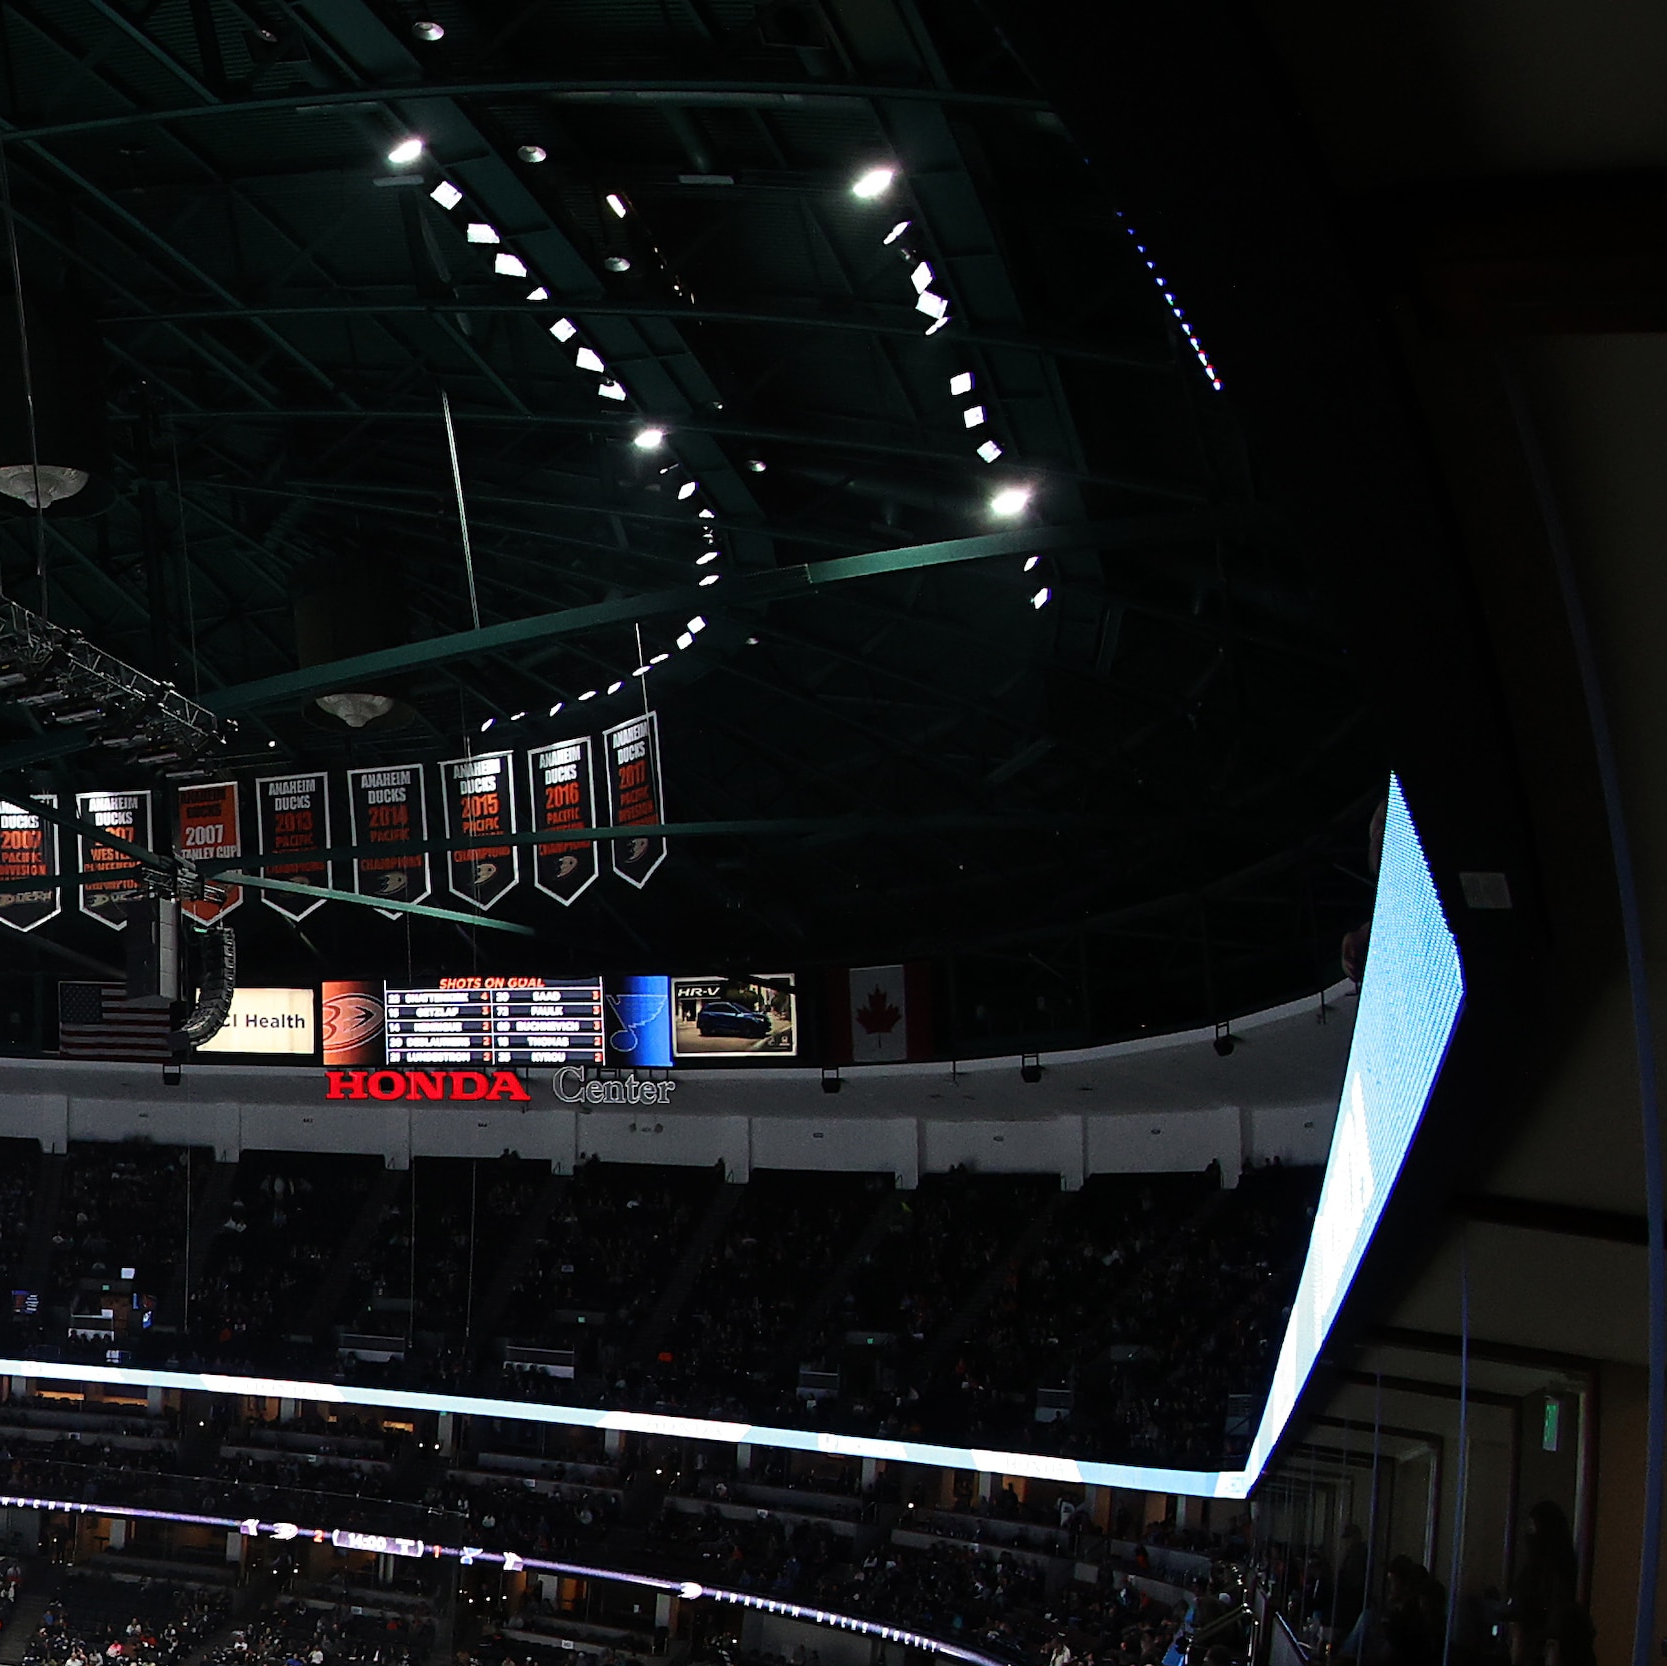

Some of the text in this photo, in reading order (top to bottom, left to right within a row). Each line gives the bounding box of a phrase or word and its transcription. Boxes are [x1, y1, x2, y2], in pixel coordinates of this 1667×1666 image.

[539, 745, 581, 769] ANAHEIM
[617, 741, 645, 765] DUCKS
[453, 758, 501, 779] ANAHEIM
[545, 764, 577, 785] DUCKS
[268, 778, 315, 796] ANAHEIM
[361, 771, 411, 788] ANAHEIM
[460, 775, 496, 795] DUCKS
[274, 795, 310, 811] DUCKS
[368, 787, 406, 805] DUCKS
[545, 781, 580, 809] 2016
[88, 797, 139, 812] ANAHEIM
[460, 793, 500, 818] 2015
[0, 814, 40, 829] DUCKS
[95, 811, 133, 826] DUCKS
[0, 831, 44, 850] 2007
[185, 825, 224, 846] 2007
[216, 846, 236, 858] CUP
[439, 977, 546, 989] SHOTS ON GOAL
[678, 986, 721, 997] HR-V
[246, 1014, 305, 1028] Health
[325, 1065, 676, 1105] HONDA Center
[347, 1533, 387, 1552] 14:00
